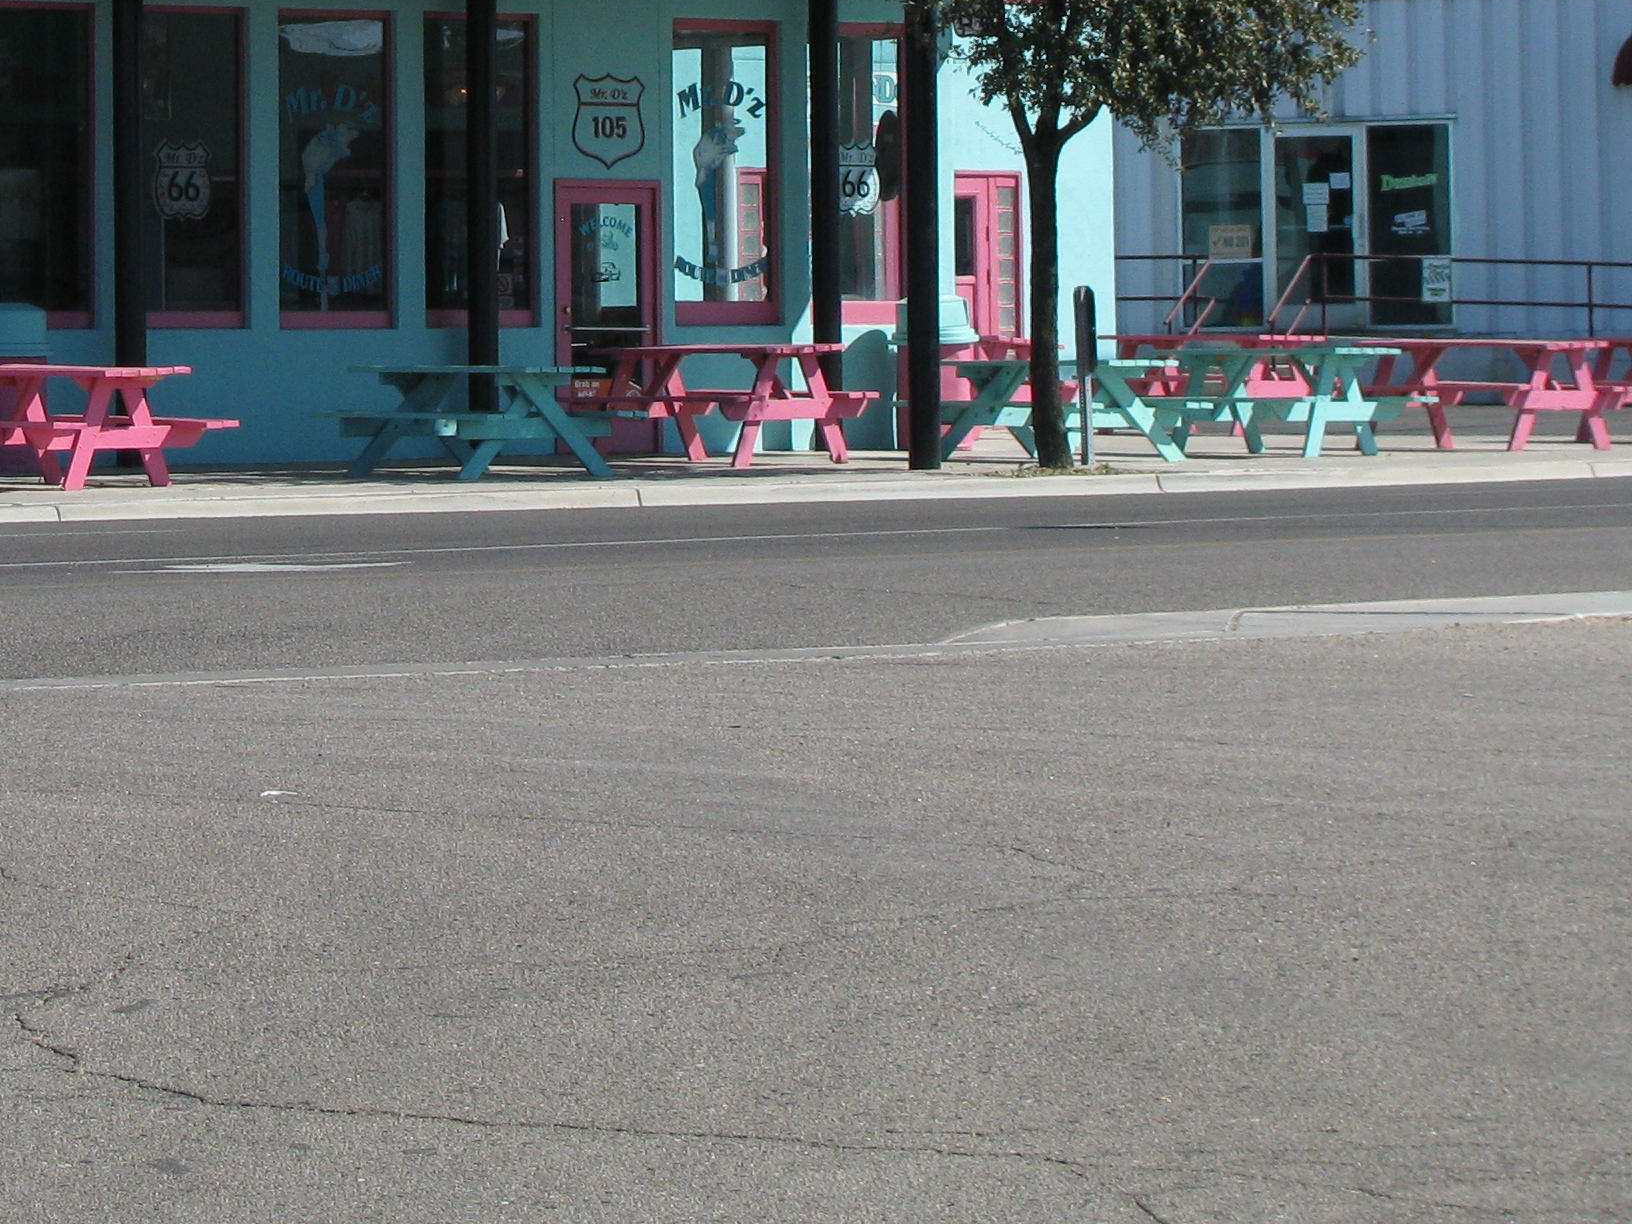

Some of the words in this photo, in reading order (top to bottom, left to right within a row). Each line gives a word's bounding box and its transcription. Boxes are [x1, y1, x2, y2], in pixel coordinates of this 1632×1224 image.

[285, 87, 327, 123] Mr.
[332, 84, 380, 123] D'z
[590, 88, 607, 100] Mr.
[610, 88, 628, 100] D'z
[723, 81, 768, 119] D'z
[592, 116, 627, 139] 105
[169, 170, 200, 202] 66
[842, 169, 870, 198] 66
[579, 216, 633, 238] WELCOME
